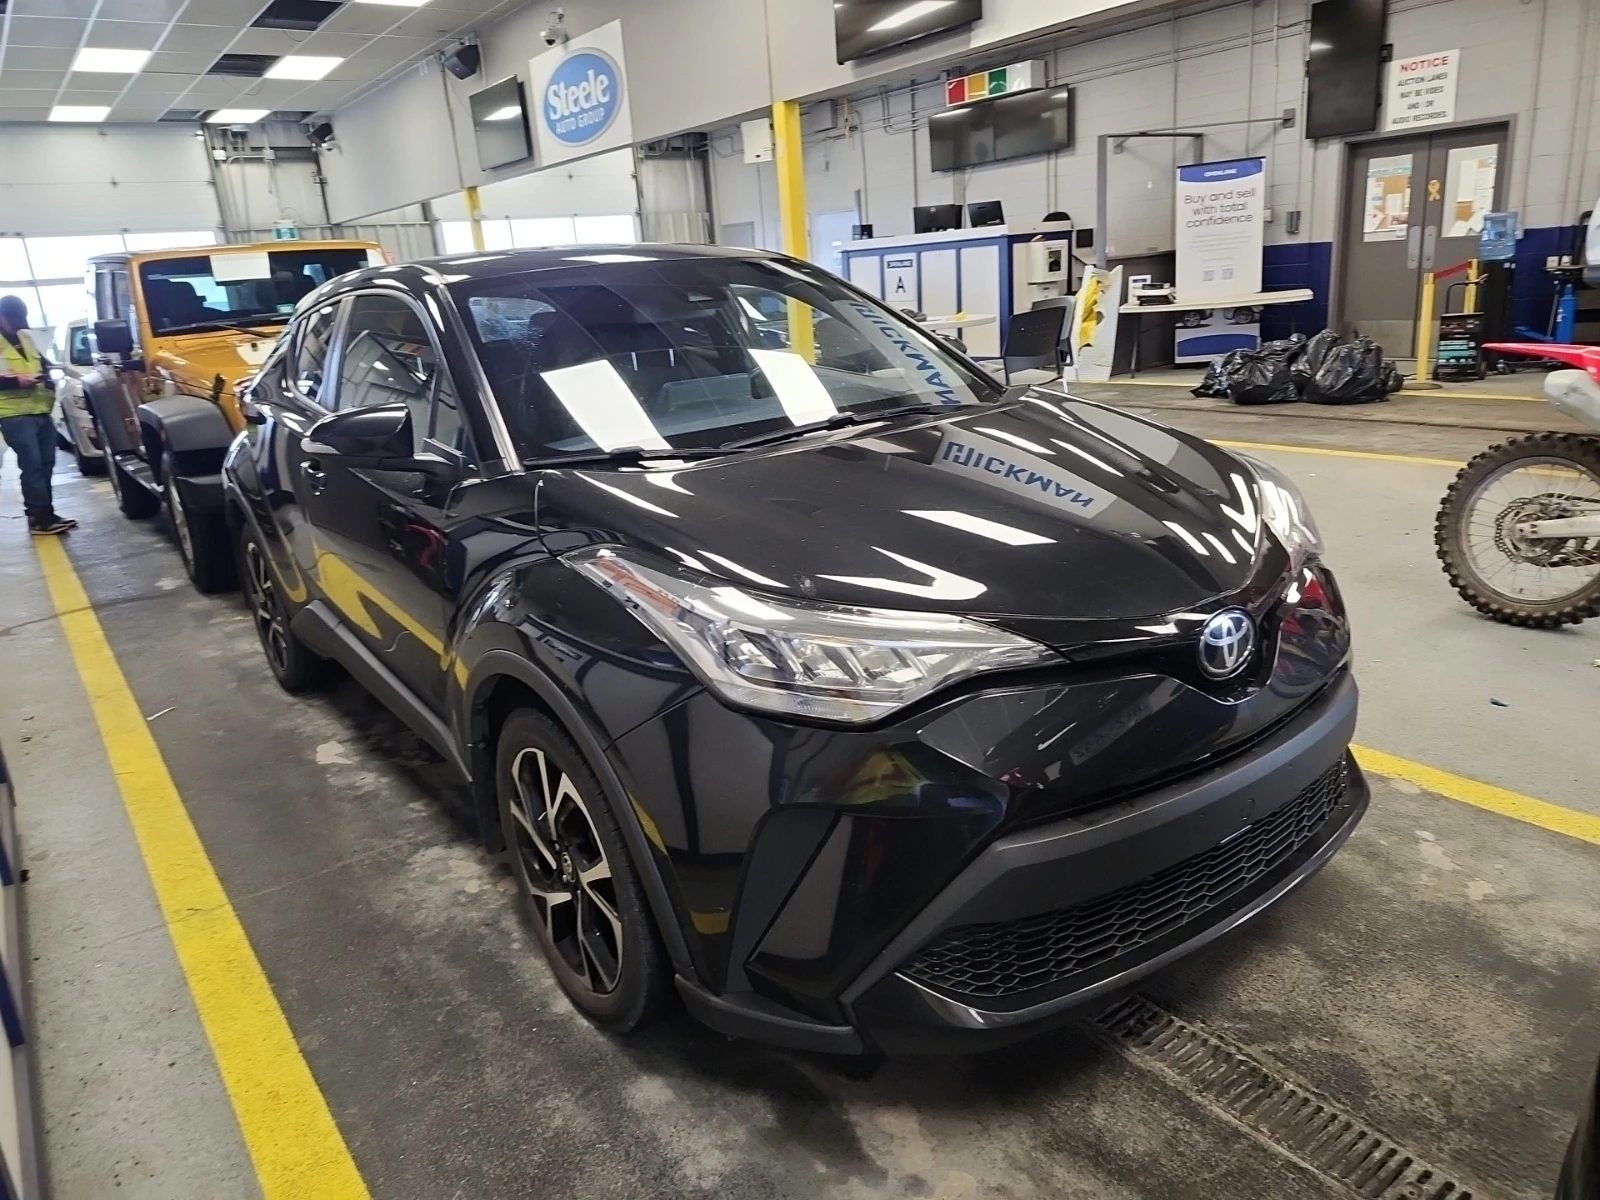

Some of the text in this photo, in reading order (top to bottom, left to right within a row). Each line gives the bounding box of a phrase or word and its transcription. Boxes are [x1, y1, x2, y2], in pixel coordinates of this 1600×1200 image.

[1400, 56, 1449, 73] NOTICE
[1397, 72, 1448, 86] AUCTION LANES
[547, 69, 610, 120] Steele
[556, 108, 605, 134] AUTO GROUP
[1184, 187, 1257, 205] Buy and sell
[1192, 201, 1248, 216] with total
[1185, 213, 1254, 229] confidence
[895, 276, 907, 293] A
